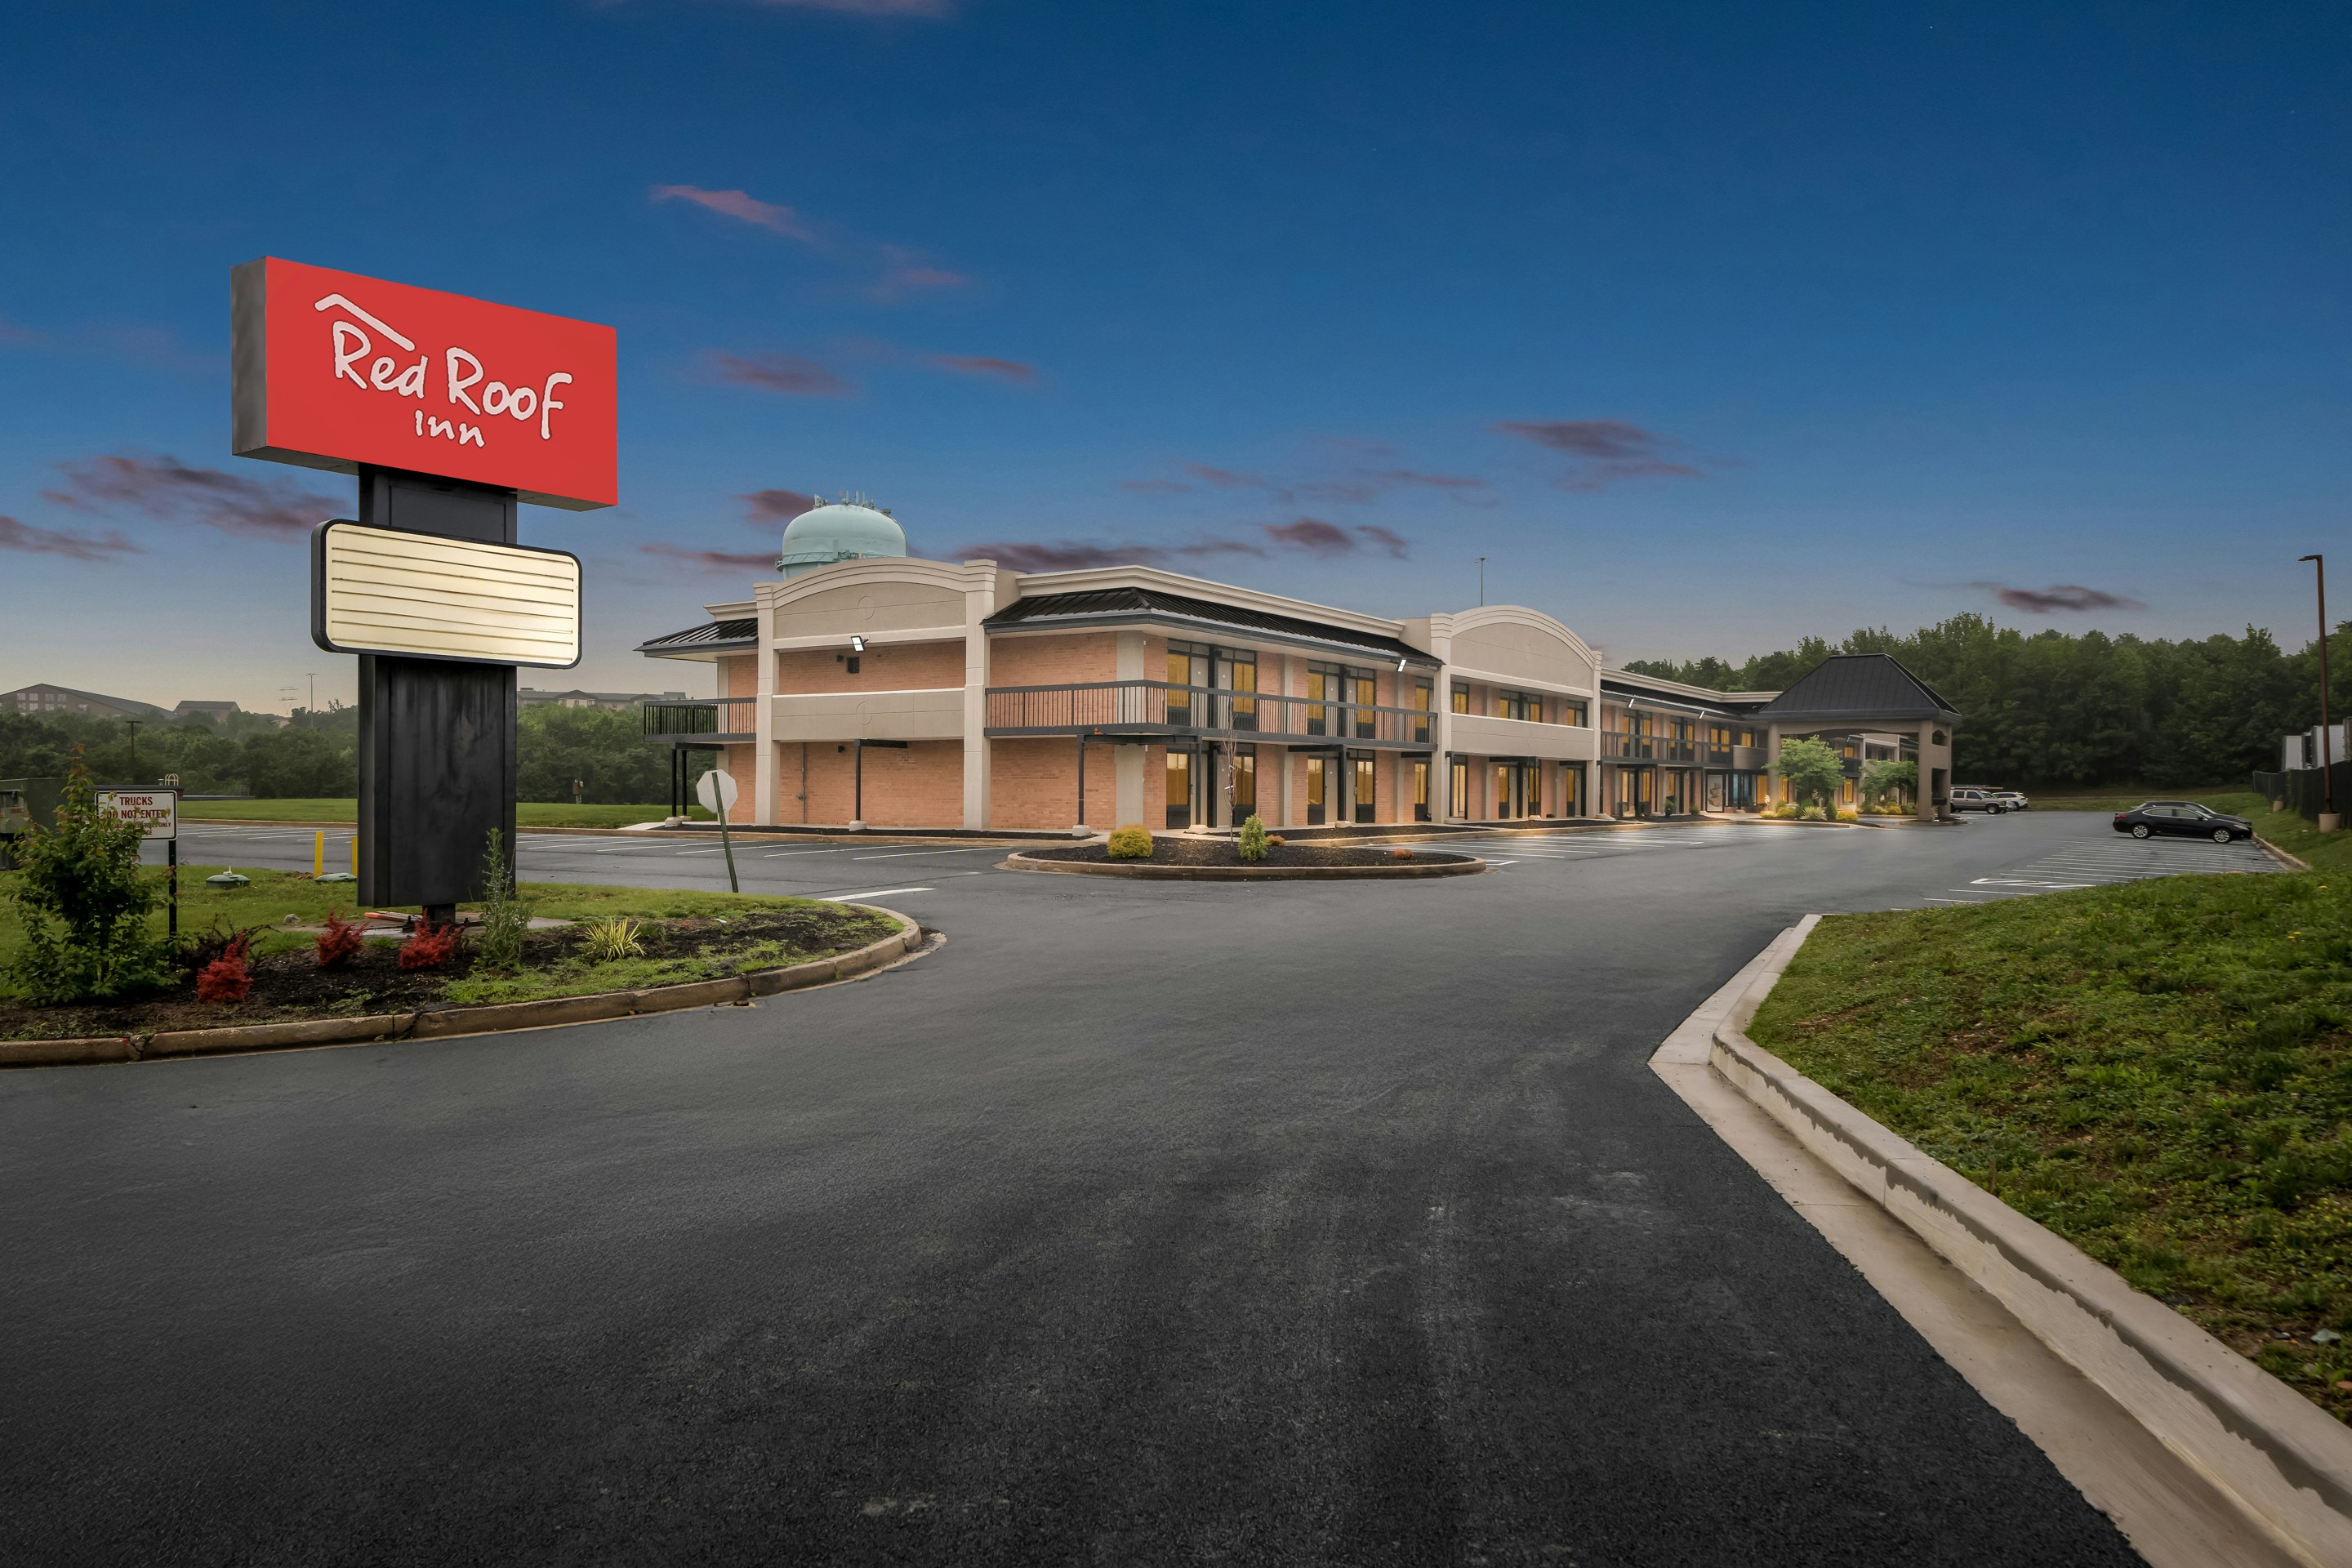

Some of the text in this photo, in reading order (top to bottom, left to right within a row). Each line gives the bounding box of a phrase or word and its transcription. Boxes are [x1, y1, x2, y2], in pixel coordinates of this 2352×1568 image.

[332, 320, 572, 439] Red Roof
[119, 796, 153, 805] TRUCKS
[121, 809, 137, 818] NOT
[140, 809, 167, 818] ENTE
